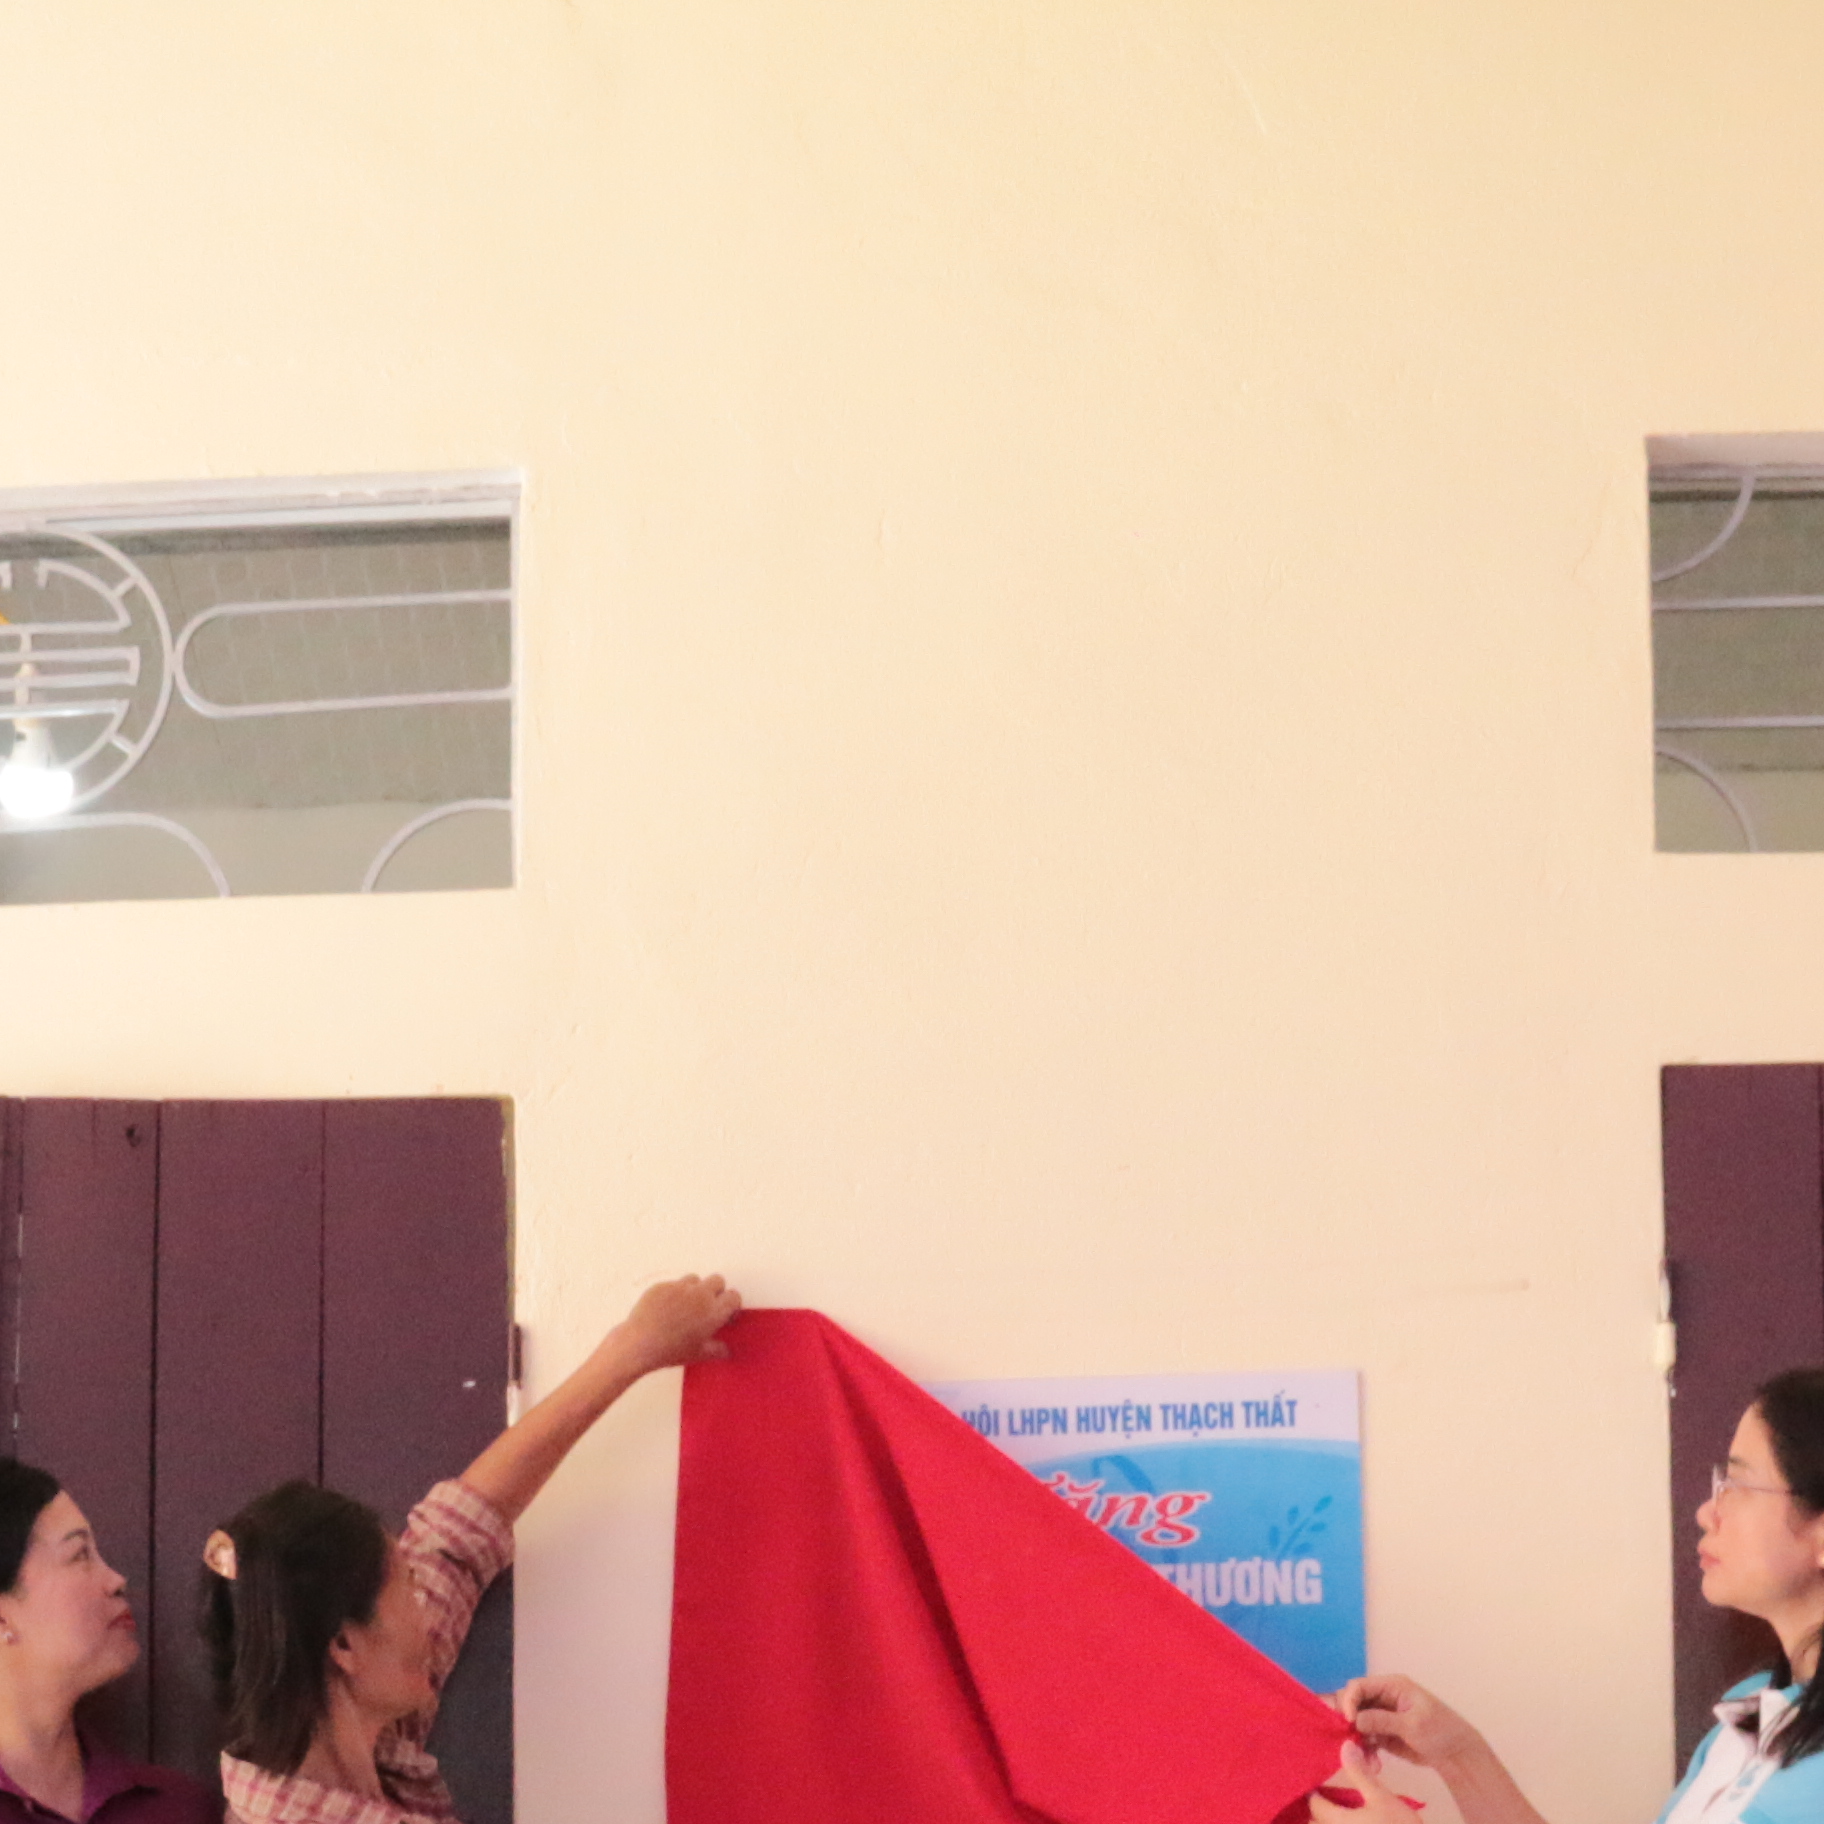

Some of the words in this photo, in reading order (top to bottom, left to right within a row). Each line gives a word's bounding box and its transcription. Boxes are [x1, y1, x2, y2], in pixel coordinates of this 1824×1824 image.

[1007, 1407, 1068, 1436] LHPN
[1076, 1398, 1152, 1439] HUYỆN
[1160, 1402, 1234, 1438] THẠCH
[1241, 1389, 1298, 1429] THẤT
